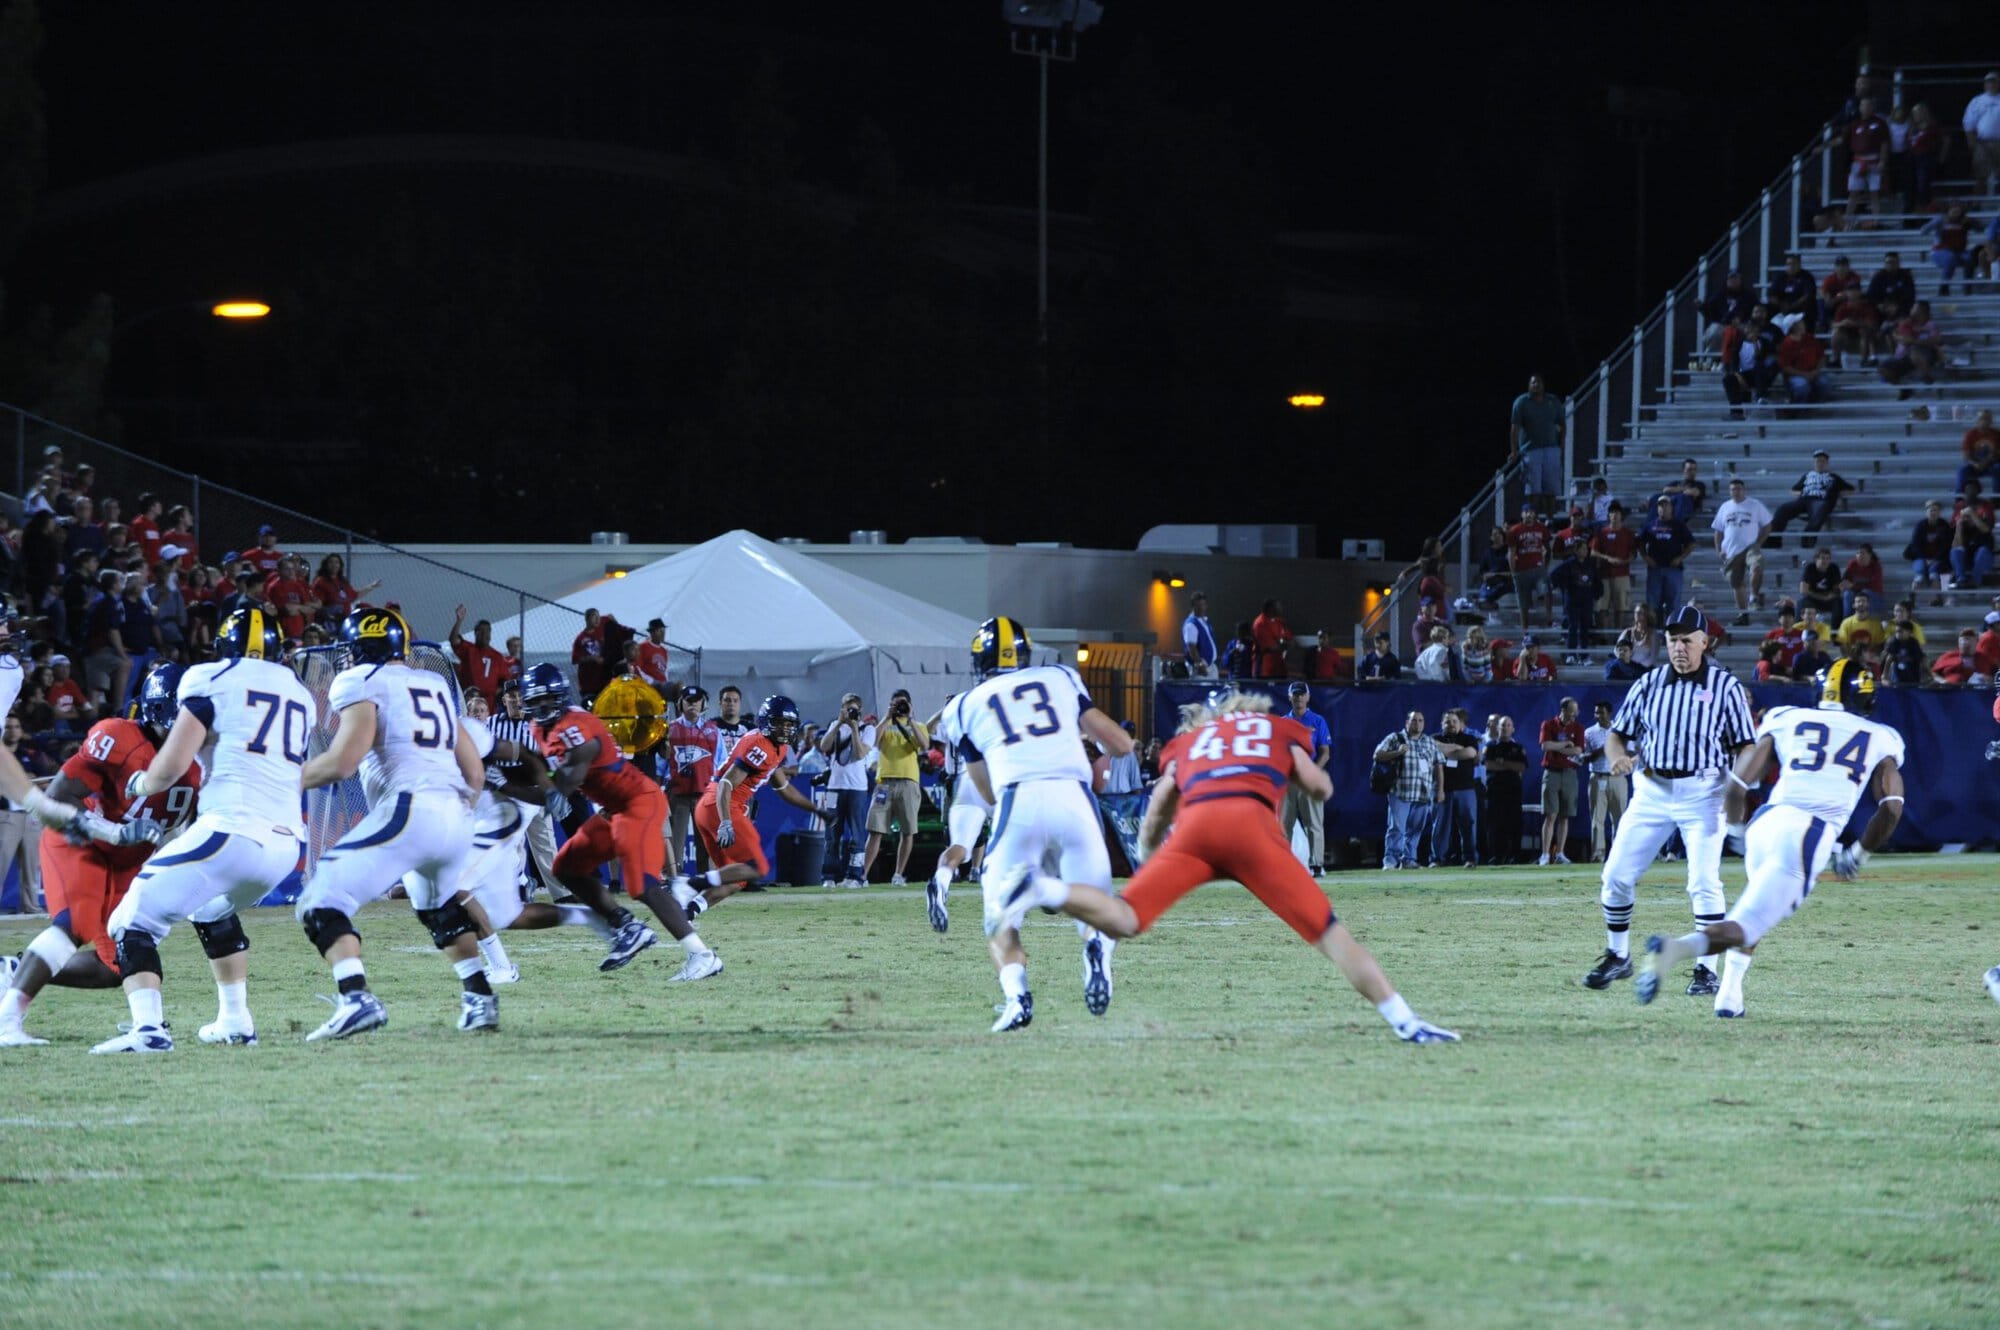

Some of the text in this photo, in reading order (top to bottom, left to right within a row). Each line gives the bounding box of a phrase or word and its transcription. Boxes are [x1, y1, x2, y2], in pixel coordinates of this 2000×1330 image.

[355, 614, 388, 638] Cal
[481, 656, 493, 679] 7
[246, 689, 309, 765] 70
[407, 687, 456, 751] 51
[986, 681, 1061, 746] 13
[87, 728, 116, 762] 49
[557, 725, 586, 749] 15
[746, 745, 768, 767] 23
[1188, 716, 1273, 760] 42
[1789, 721, 1872, 786] 34
[122, 786, 194, 831] 49
